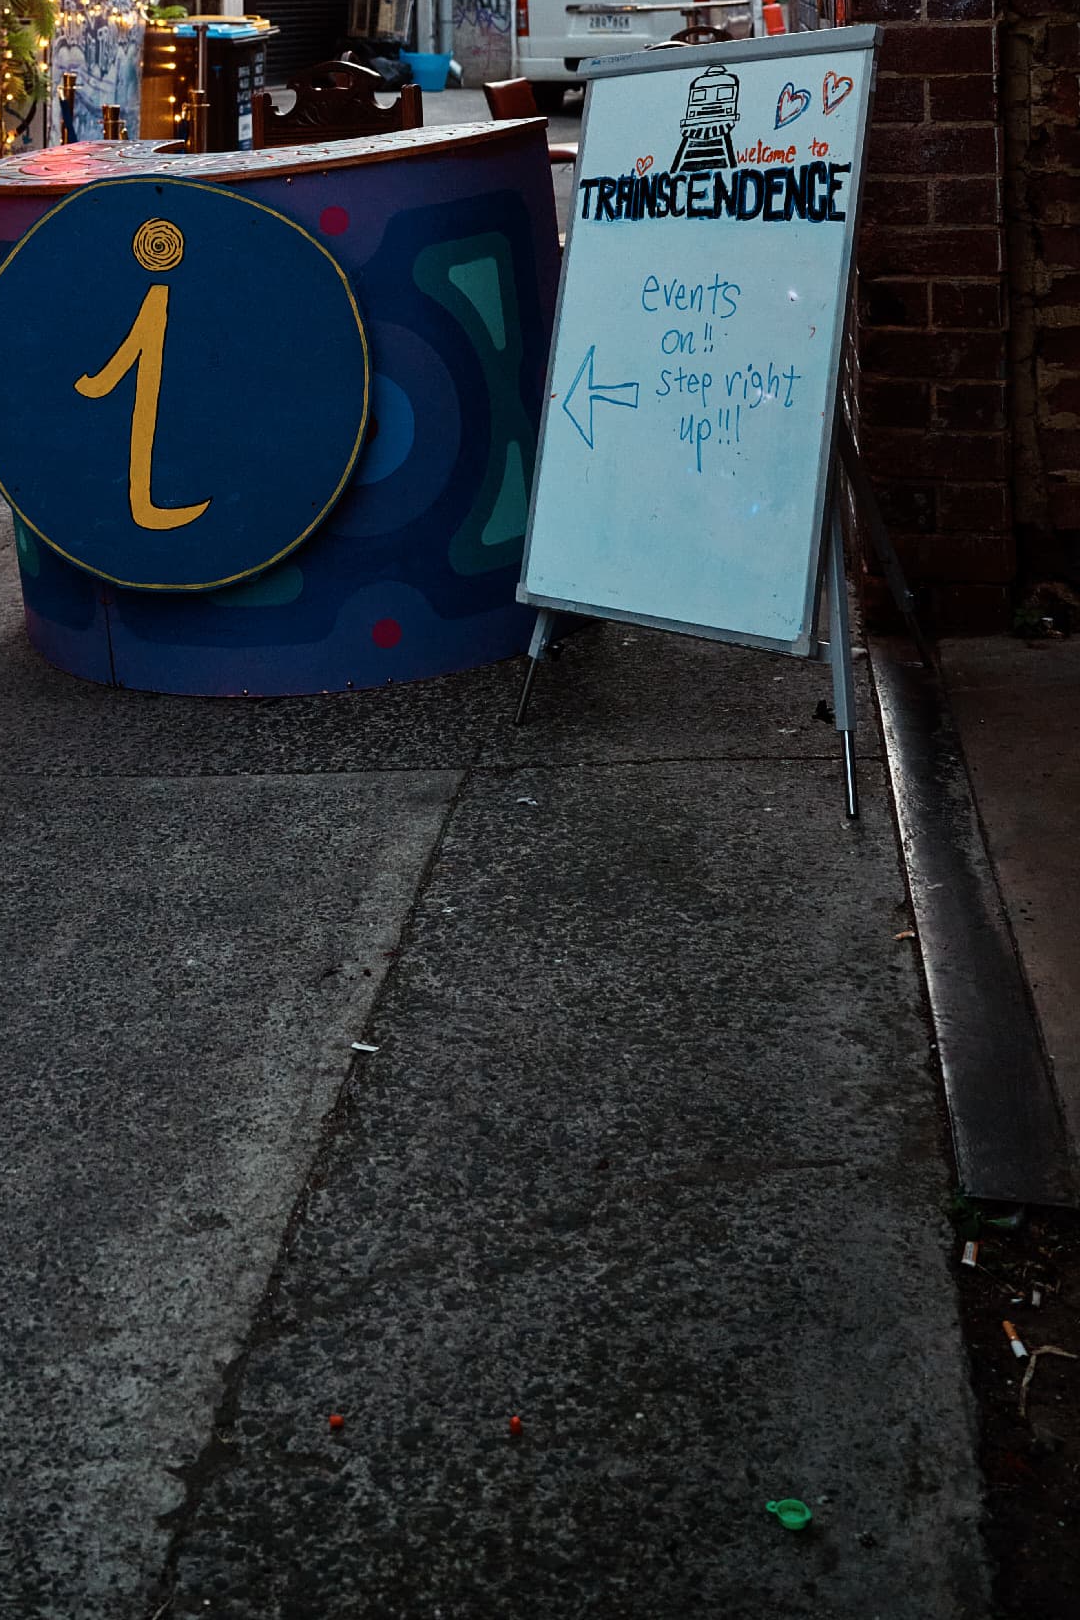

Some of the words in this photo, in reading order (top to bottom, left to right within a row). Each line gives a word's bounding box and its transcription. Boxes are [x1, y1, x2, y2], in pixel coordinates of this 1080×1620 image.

[736, 139, 797, 164] welcome
[642, 273, 741, 319] events
[661, 322, 714, 355] on!!
[656, 367, 713, 408] step
[725, 362, 802, 409] right
[679, 404, 741, 473] up!!!
